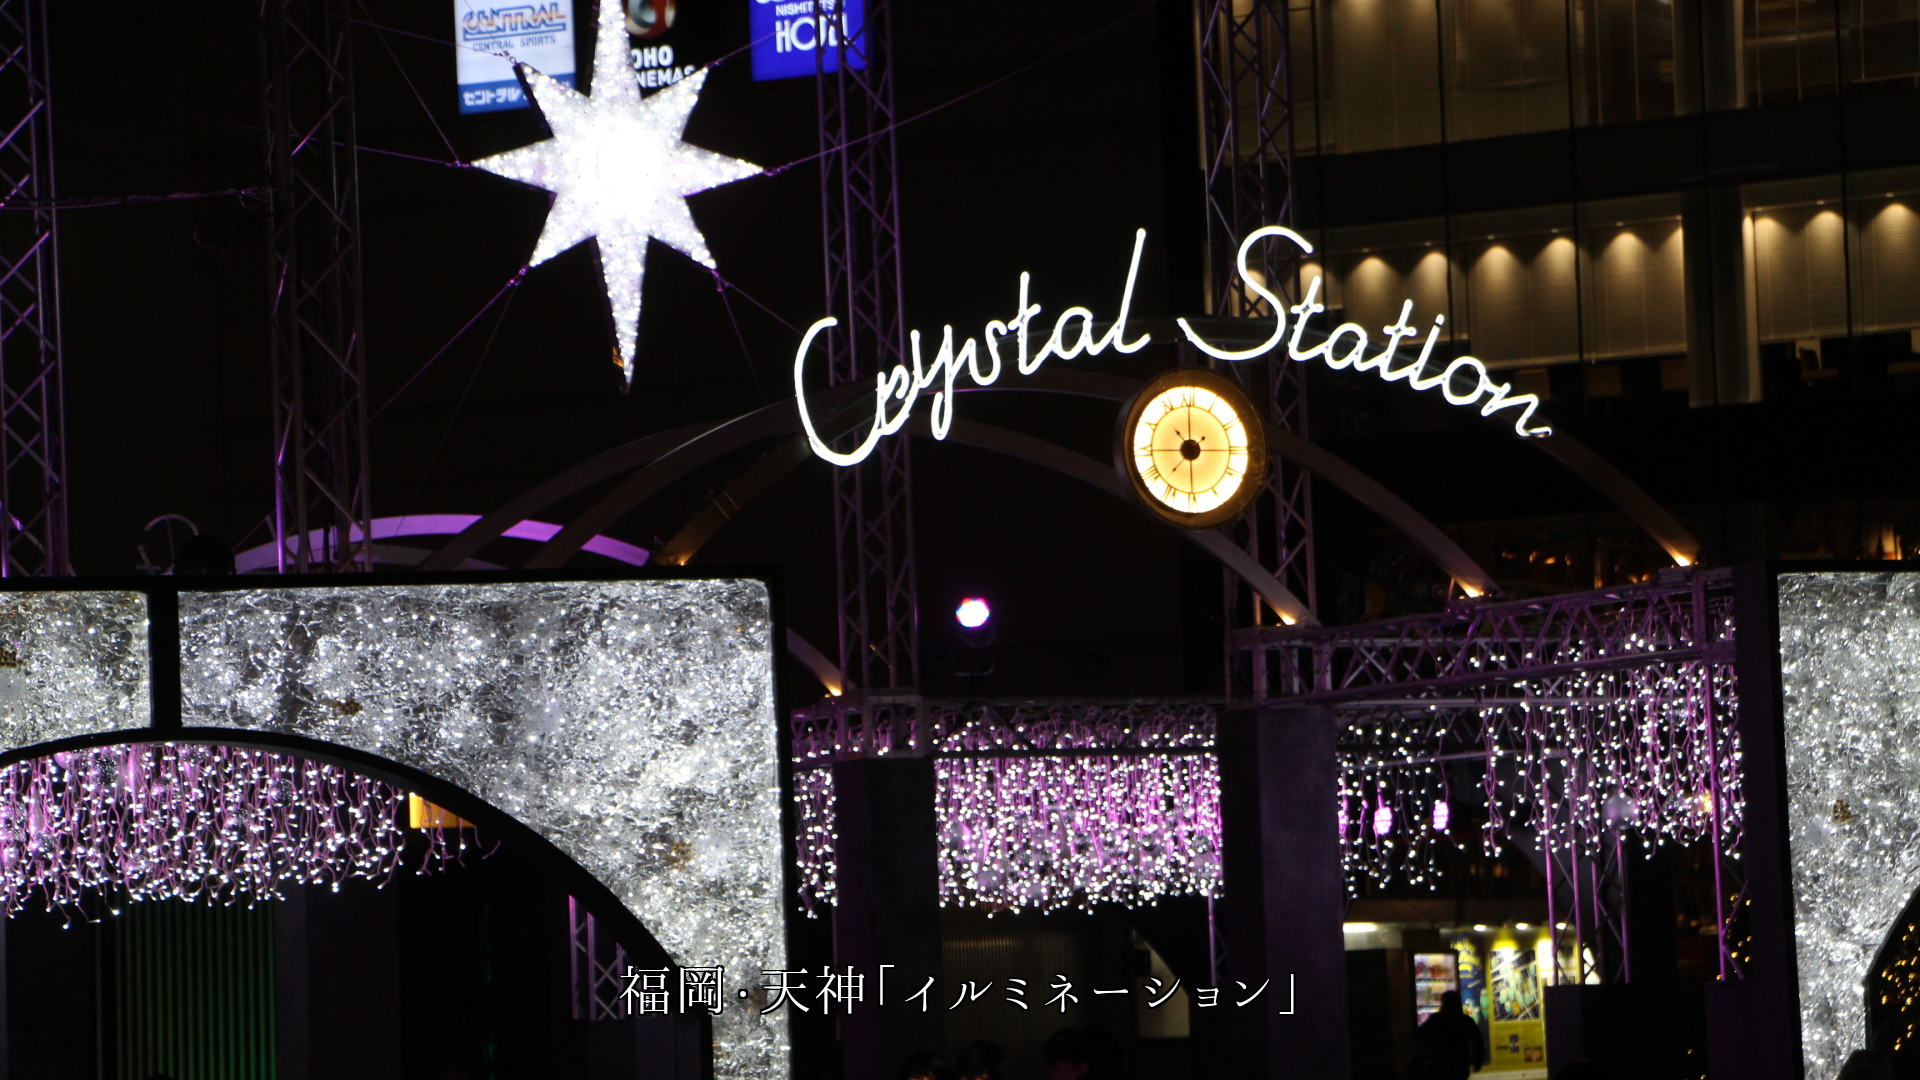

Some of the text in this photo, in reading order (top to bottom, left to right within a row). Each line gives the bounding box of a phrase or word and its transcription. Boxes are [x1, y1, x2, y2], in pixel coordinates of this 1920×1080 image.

[462, 2, 566, 38] CENTRAL
[775, 0, 846, 17] NISHITTS
[472, 34, 556, 51] CENTRAL SPORTS
[631, 44, 674, 70] OHO
[635, 64, 696, 88] NEMAS
[463, 86, 527, 106] セントラル
[793, 224, 1553, 466] Crystal Station
